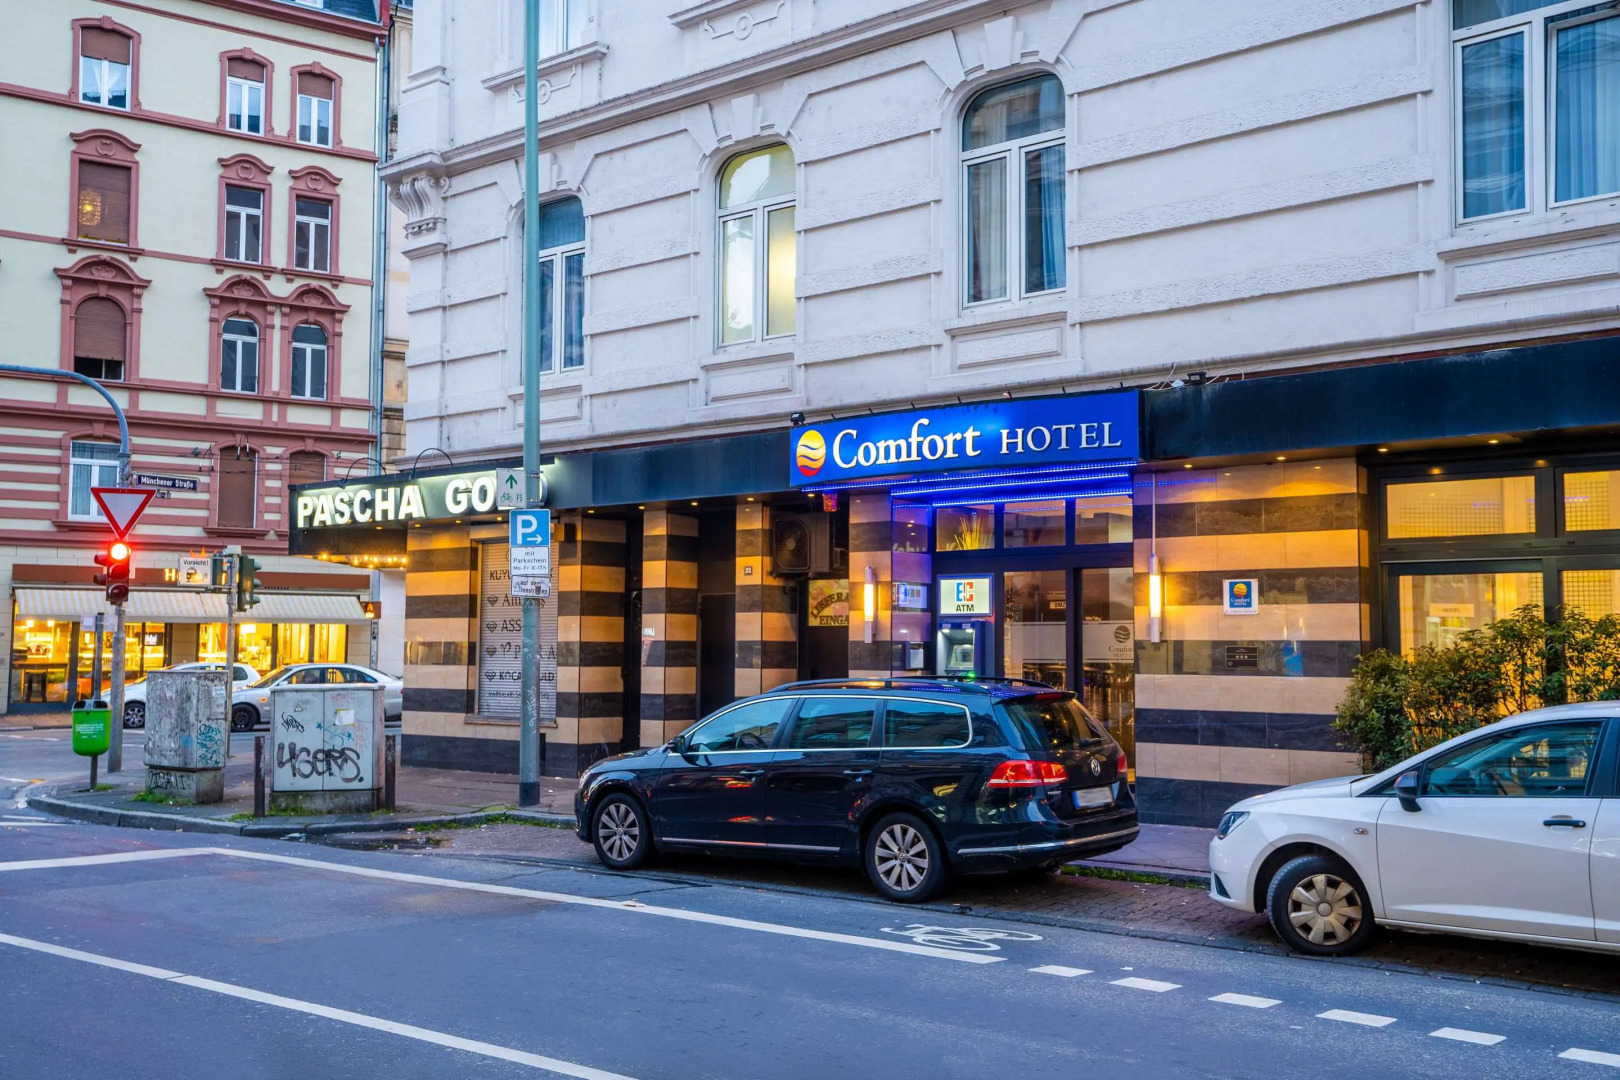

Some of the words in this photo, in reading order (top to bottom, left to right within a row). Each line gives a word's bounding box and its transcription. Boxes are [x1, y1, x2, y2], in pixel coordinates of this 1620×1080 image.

[833, 418, 981, 469] Comfort
[1000, 422, 1122, 454] HOTEL
[141, 476, 173, 487] Münchener
[175, 480, 194, 489] Straße
[297, 484, 426, 528] PASCHA
[445, 474, 548, 514] GO
[516, 515, 538, 545] P
[956, 604, 975, 612] ATM
[1108, 645, 1133, 653] Comfor
